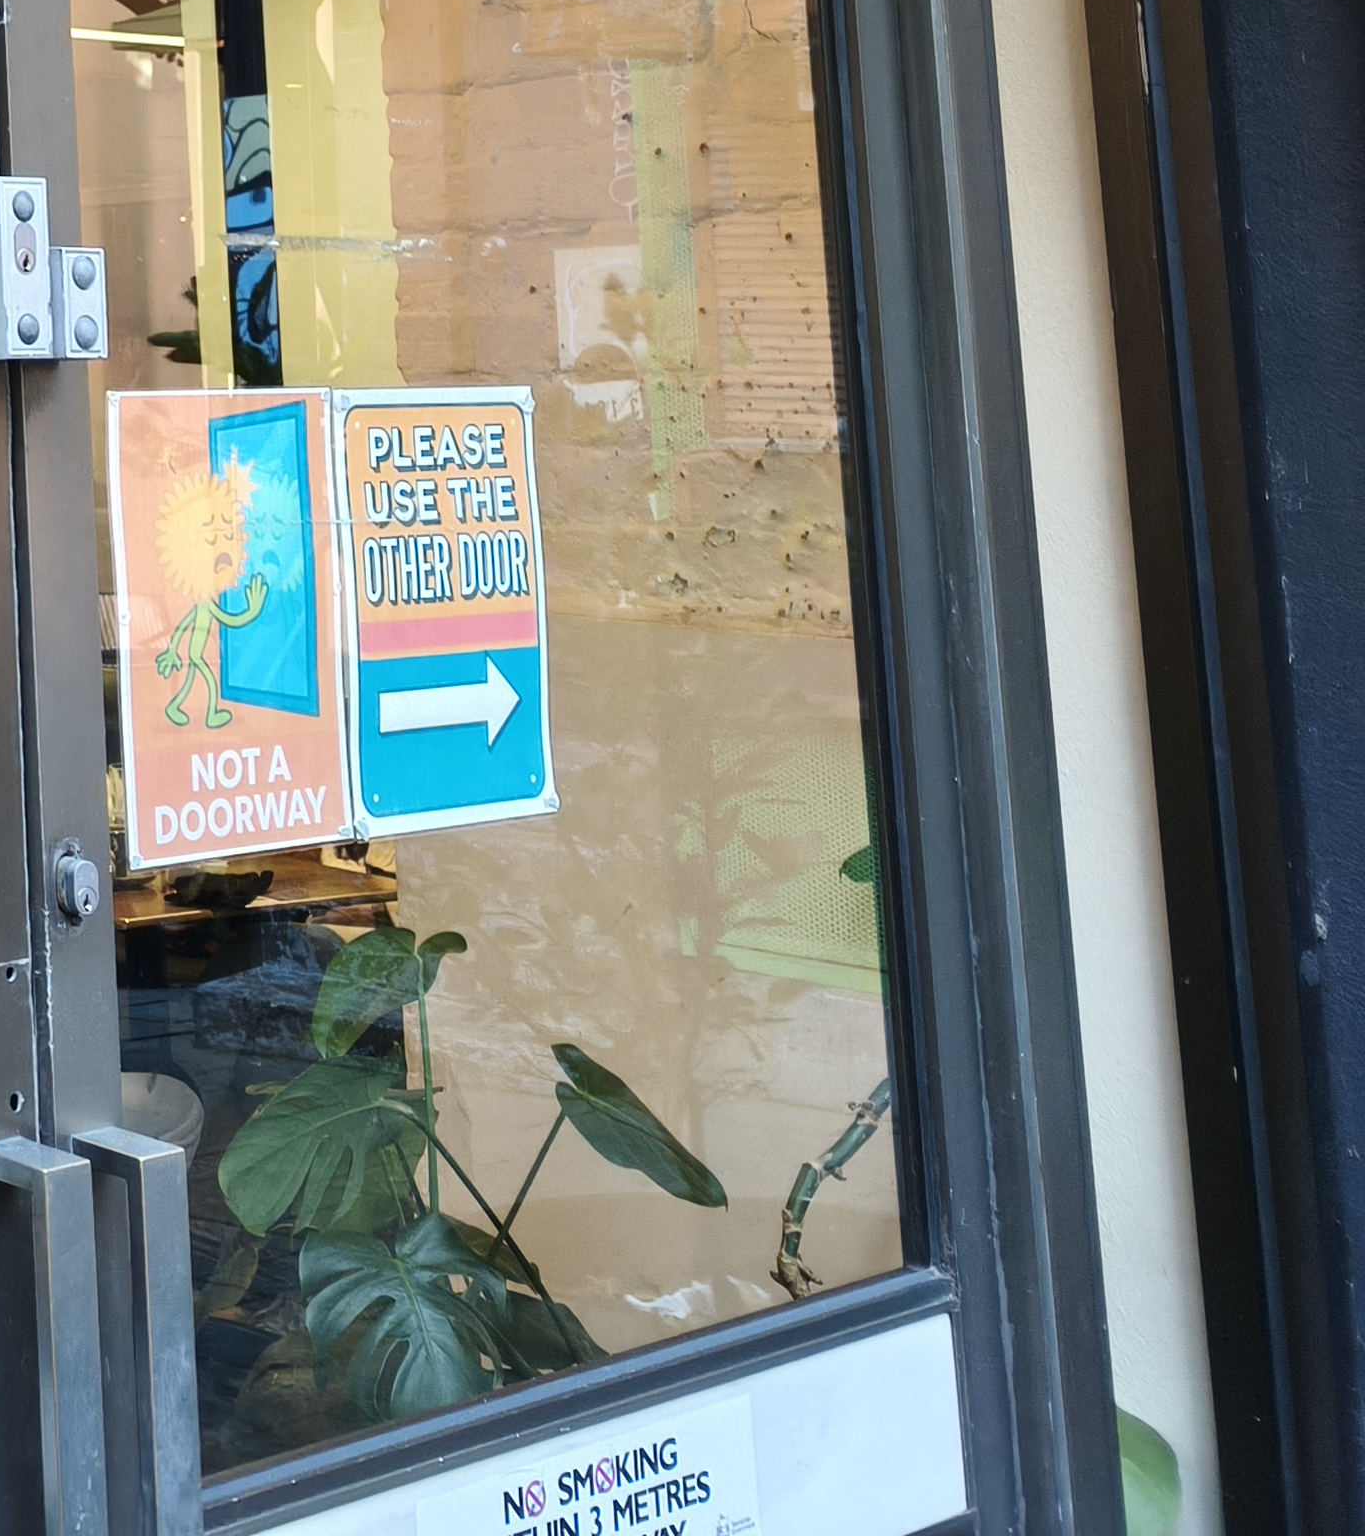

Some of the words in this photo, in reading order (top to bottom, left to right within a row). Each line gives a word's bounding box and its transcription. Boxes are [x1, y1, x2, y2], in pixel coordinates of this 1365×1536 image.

[367, 422, 507, 473] PLEASE
[364, 478, 440, 527] USE
[447, 475, 519, 523] THE
[362, 534, 453, 607] OTHER
[458, 530, 530, 601] DOOR
[191, 746, 260, 794] NOT
[266, 744, 291, 784] A
[155, 785, 327, 846] DOORWAY
[503, 1479, 547, 1525] NO
[557, 1437, 679, 1506] SMOKING
[590, 1506, 603, 1536] 3
[612, 1470, 711, 1532] METRES
